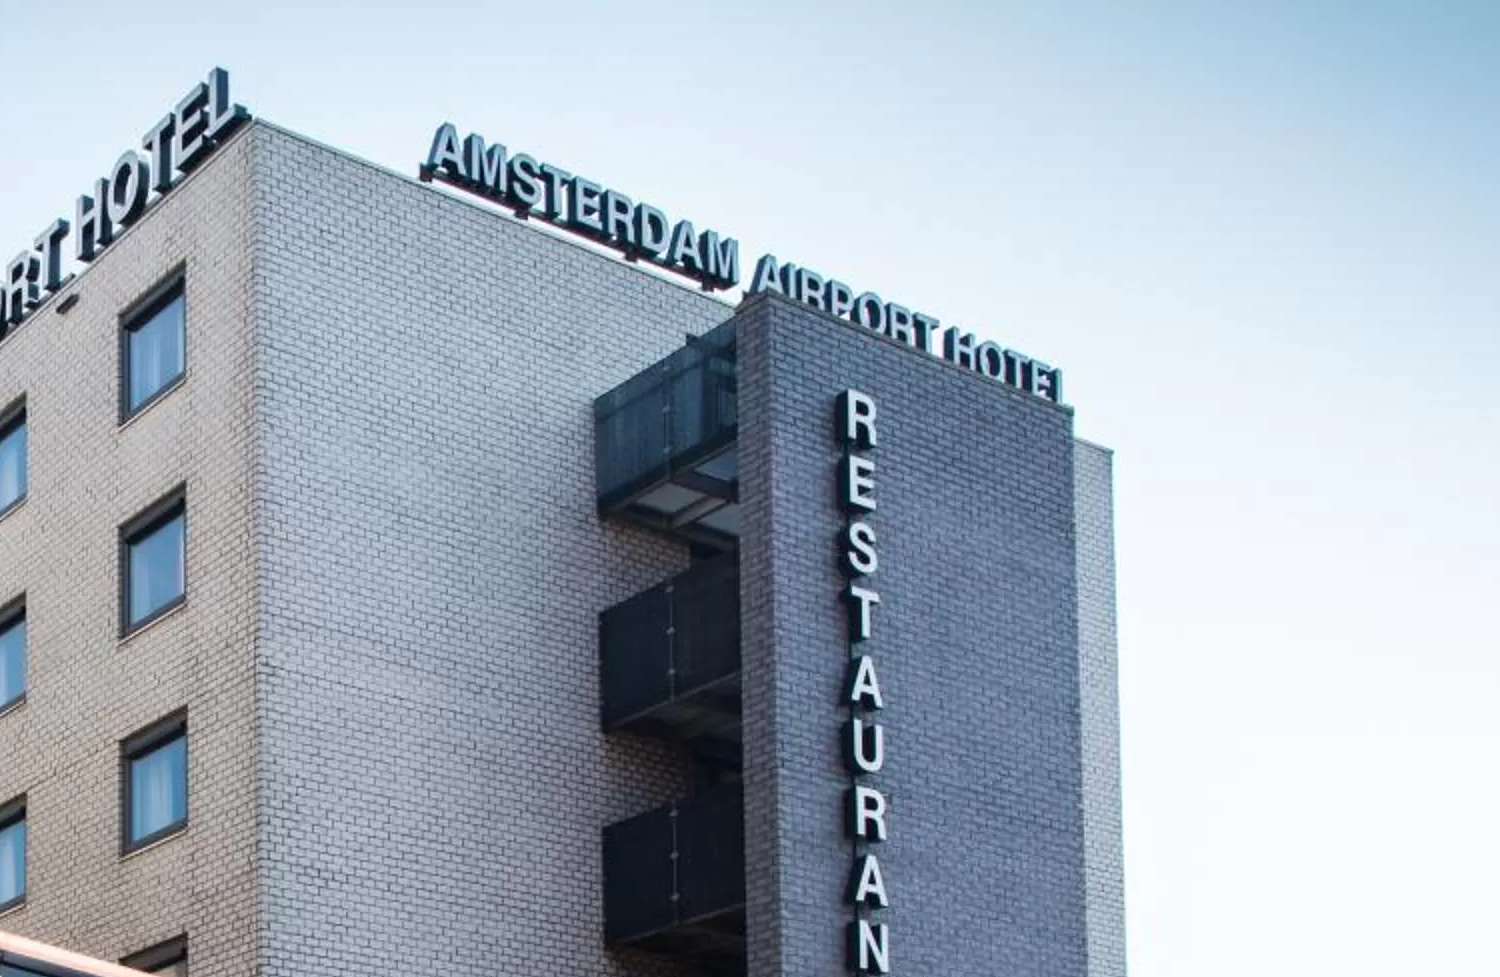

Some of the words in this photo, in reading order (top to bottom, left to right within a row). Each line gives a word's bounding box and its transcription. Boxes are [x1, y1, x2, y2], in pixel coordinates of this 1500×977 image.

[76, 67, 251, 262] HOTEL
[427, 122, 740, 286] AMSTERDAM
[750, 254, 940, 354] AIRPORT
[944, 326, 1064, 406] HOTEL
